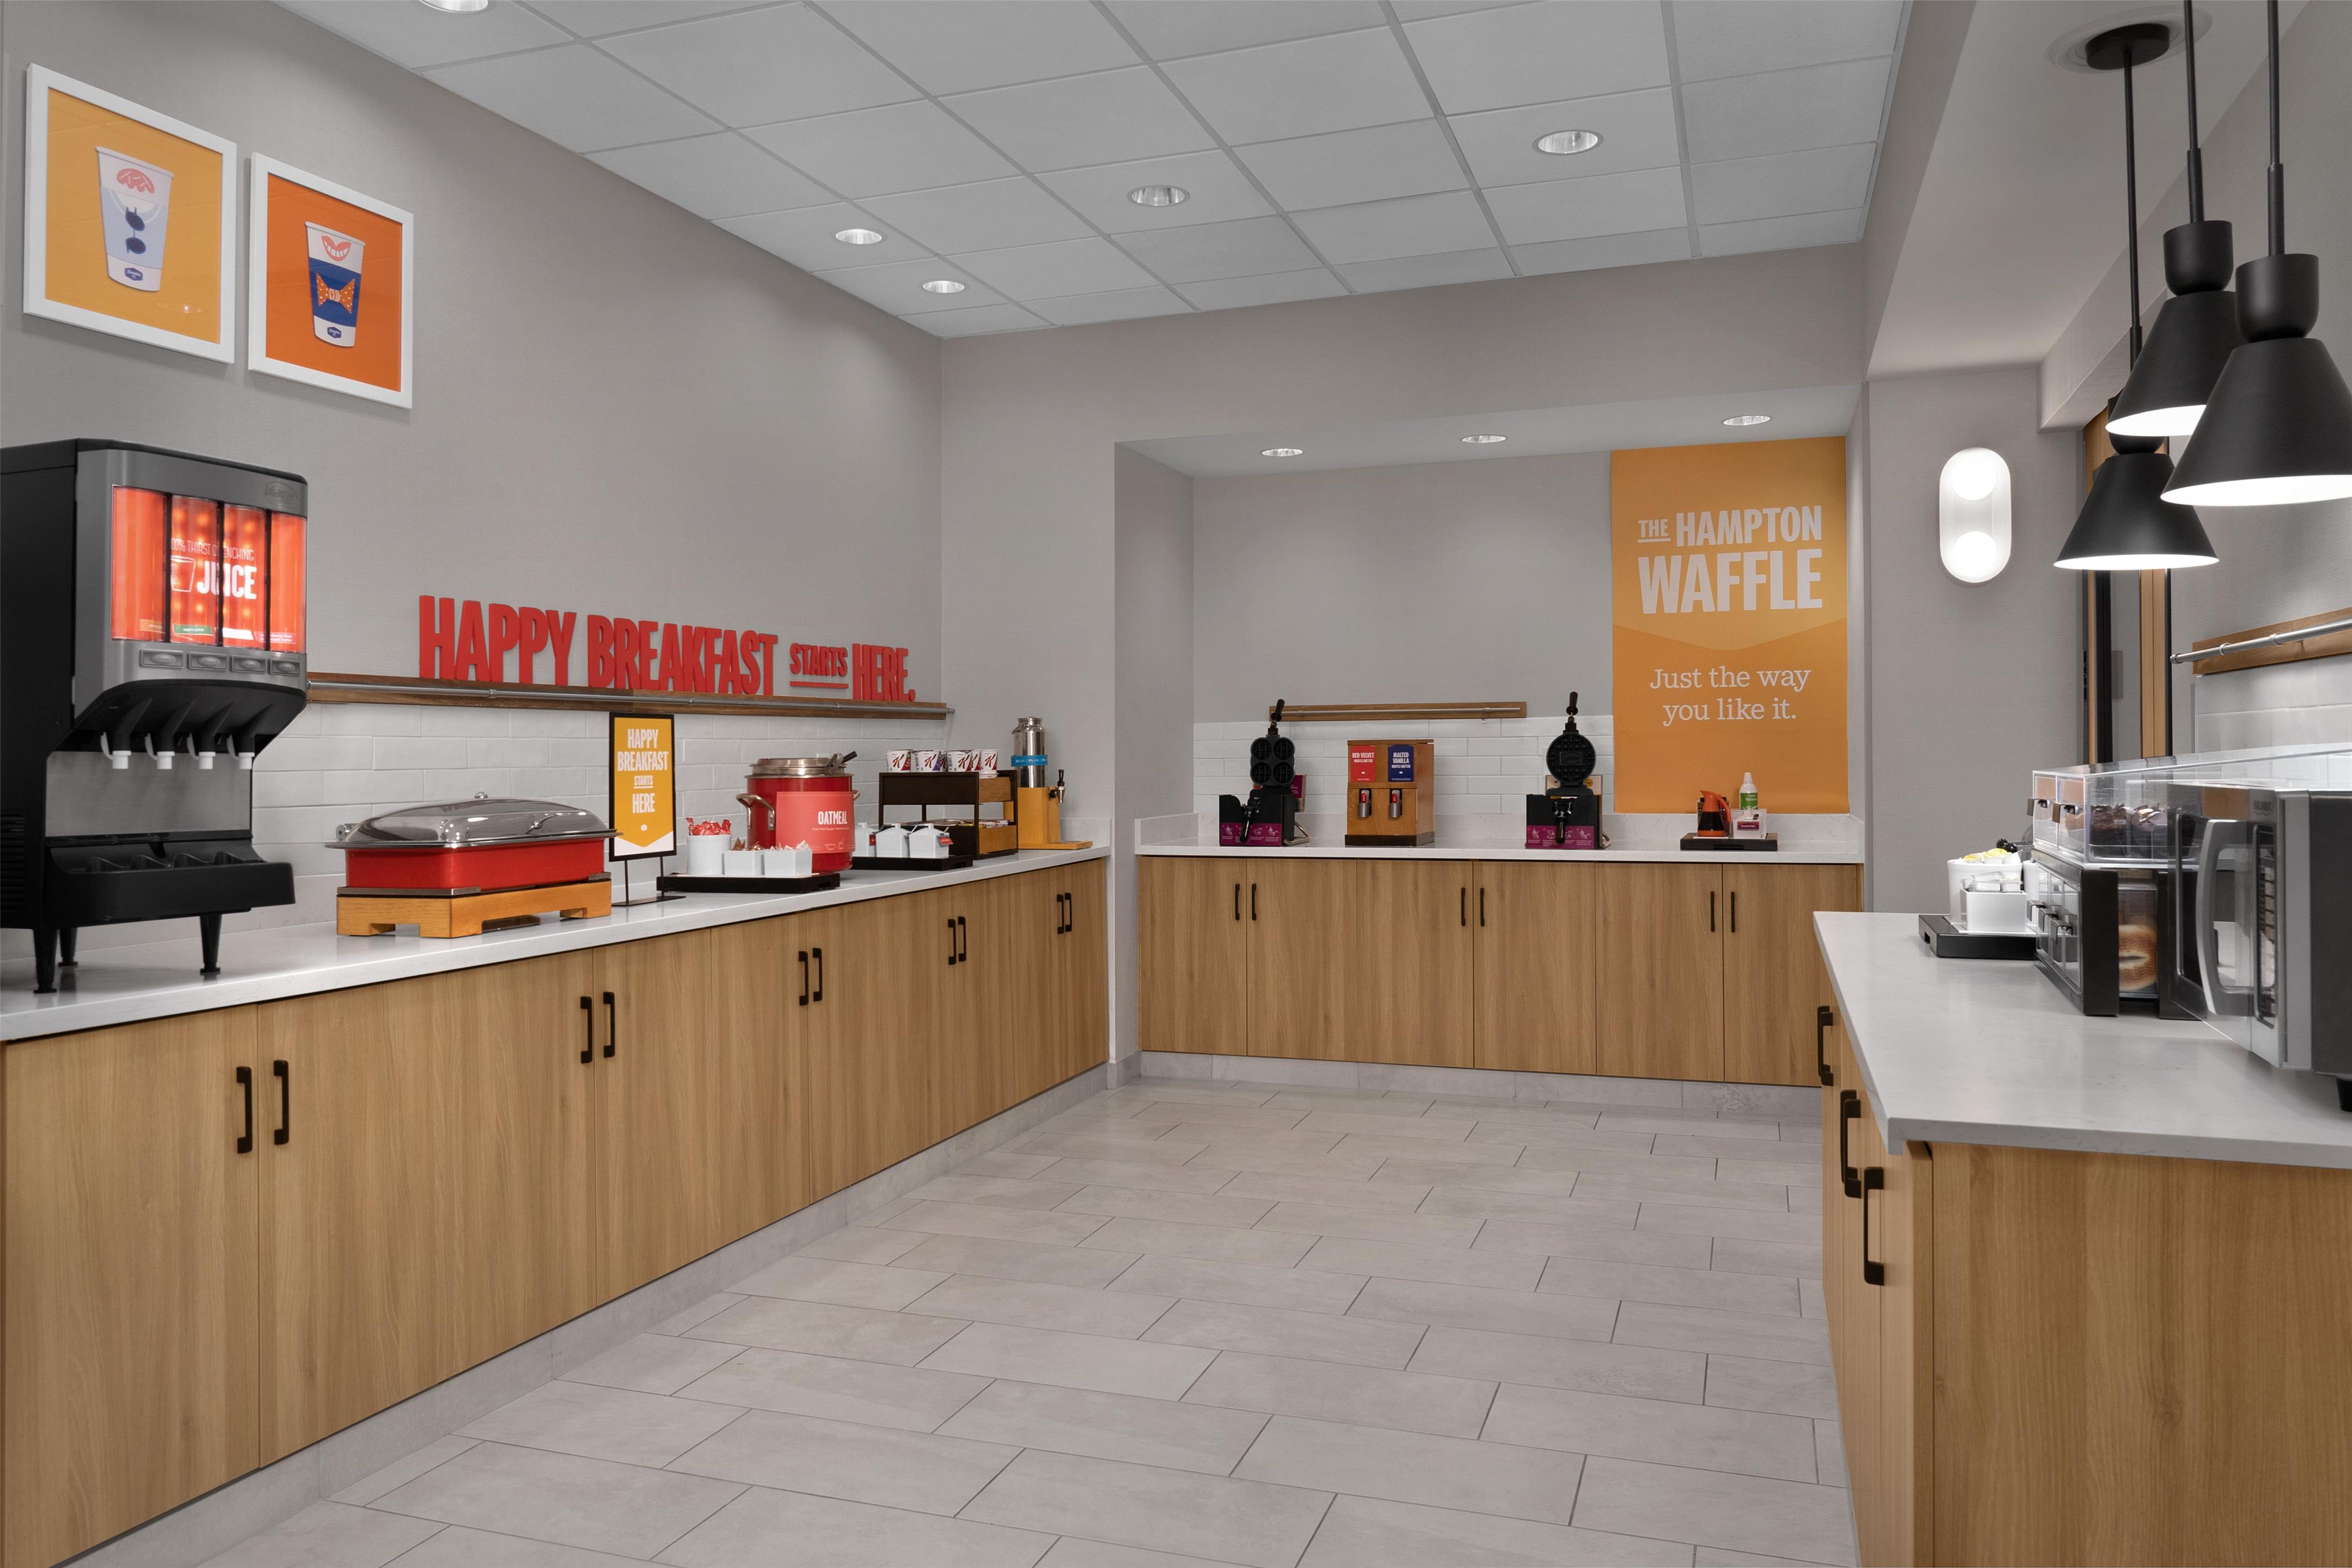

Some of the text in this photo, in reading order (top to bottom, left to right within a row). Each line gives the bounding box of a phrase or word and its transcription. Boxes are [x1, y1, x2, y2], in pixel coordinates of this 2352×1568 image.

[1638, 505, 1822, 547] THE HAMPTON
[170, 537, 186, 552] 00%
[187, 540, 212, 556] THIRST
[197, 560, 257, 599] JUICE
[1638, 548, 1823, 614] WAFFLE
[419, 595, 916, 702] HAPPY BREAKFAST STARTS HERE.
[1650, 665, 1812, 692] Just the way
[1662, 697, 1797, 727] you like it.
[627, 728, 659, 749] HAPPY
[617, 751, 669, 771] BREAKFAST
[634, 775, 653, 786] STARTS
[632, 793, 656, 814] HERE
[818, 811, 848, 825] OATMEAL
